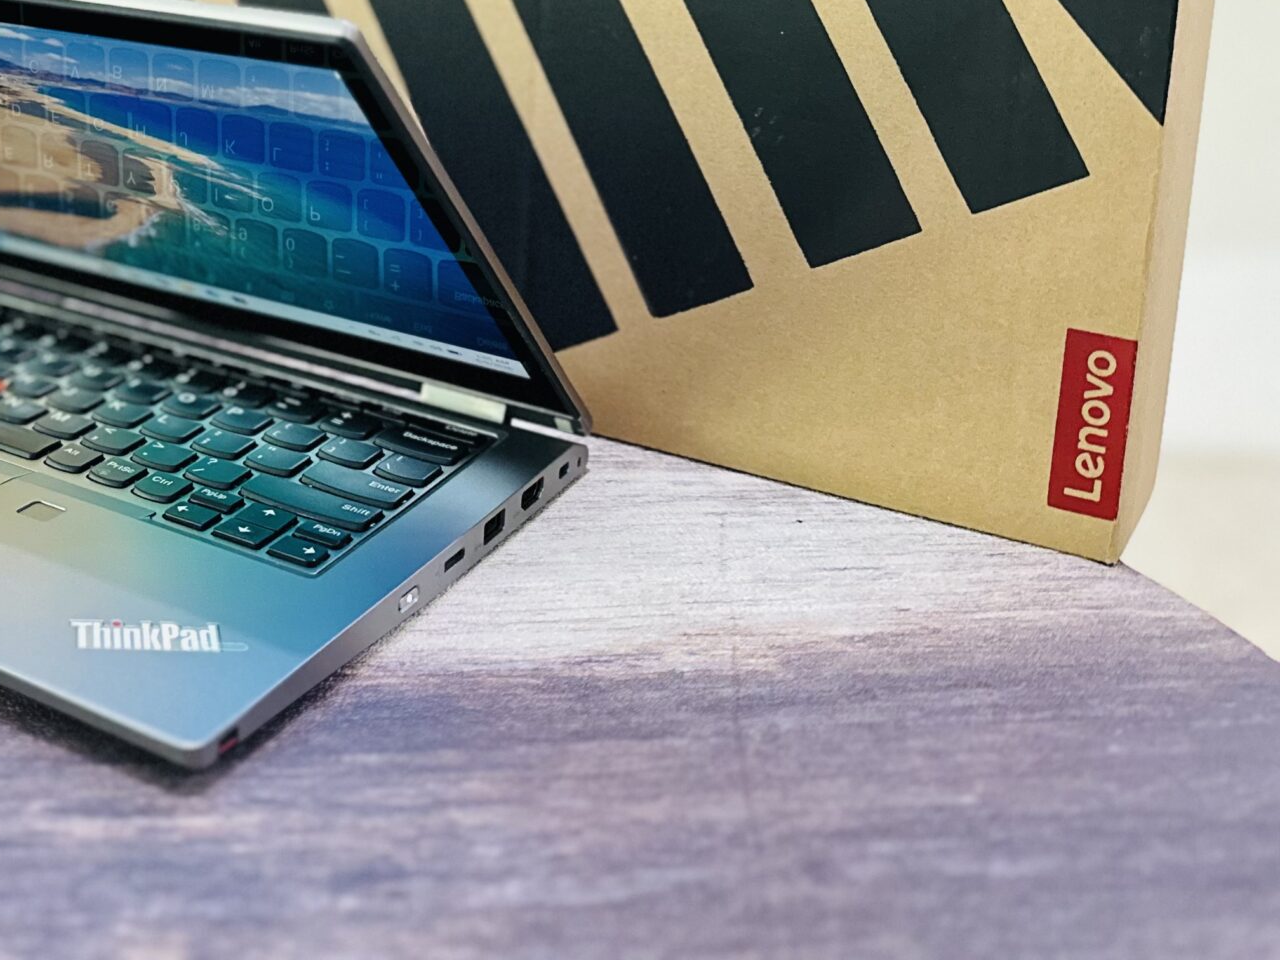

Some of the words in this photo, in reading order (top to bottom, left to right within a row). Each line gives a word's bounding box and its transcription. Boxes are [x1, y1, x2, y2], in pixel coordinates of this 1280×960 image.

[1063, 350, 1117, 502] Lenovo
[403, 431, 459, 451] Backspace
[107, 461, 135, 473] PrtSc
[152, 476, 174, 486] Ctrl
[368, 480, 401, 494] Enter
[201, 488, 227, 500] PgUp
[341, 503, 371, 516] Shift
[313, 523, 341, 536] PgDn
[70, 619, 221, 653] ThinkPad
